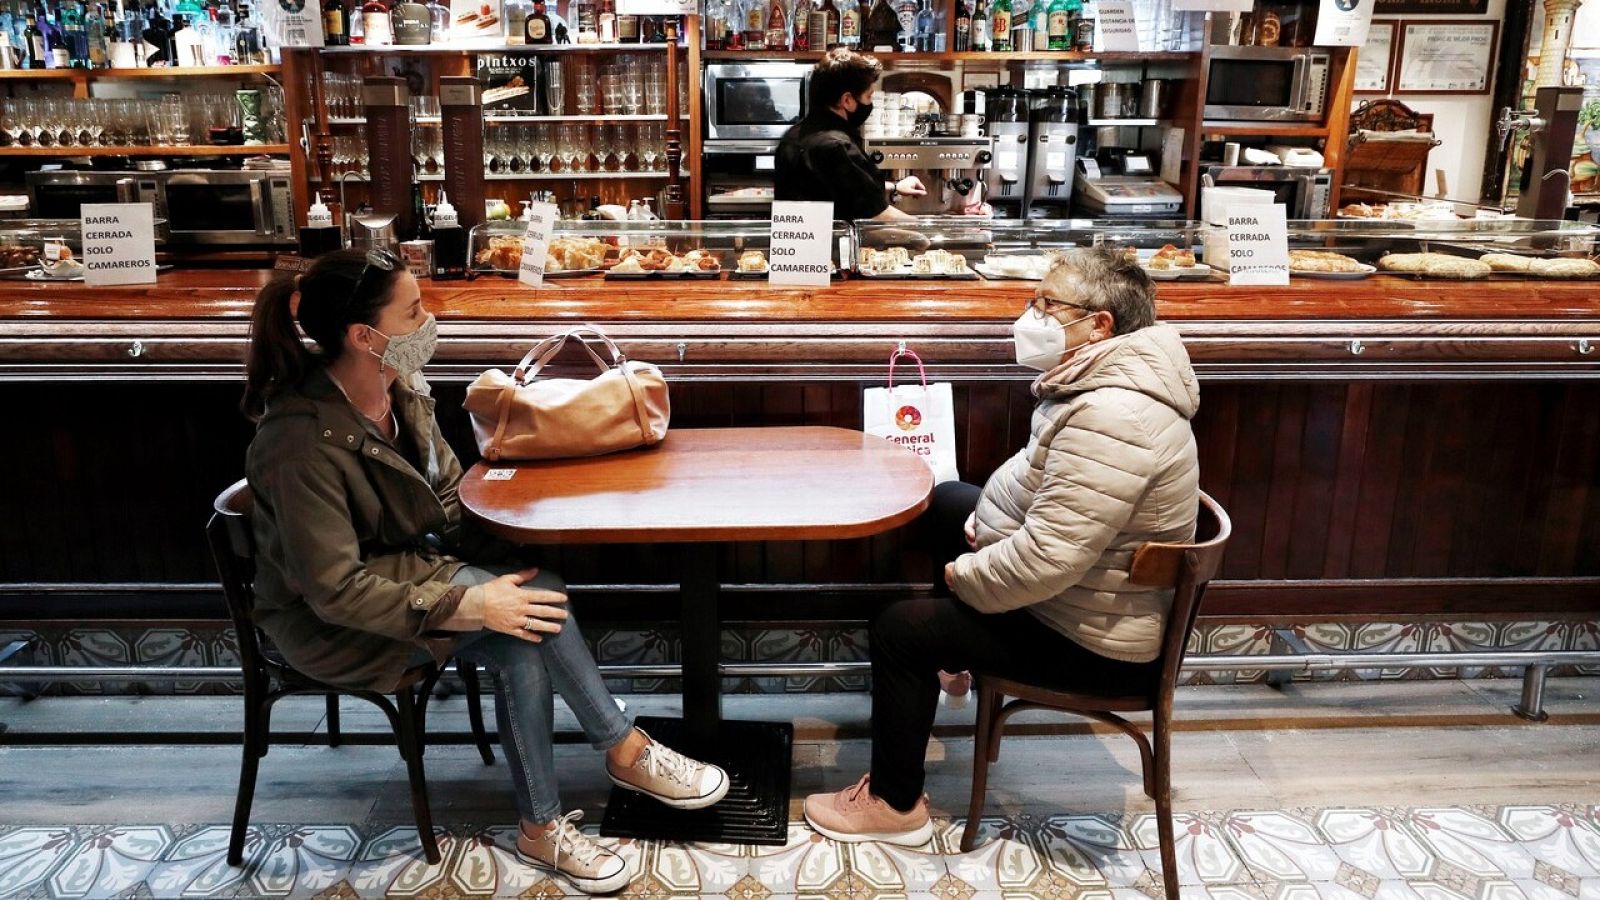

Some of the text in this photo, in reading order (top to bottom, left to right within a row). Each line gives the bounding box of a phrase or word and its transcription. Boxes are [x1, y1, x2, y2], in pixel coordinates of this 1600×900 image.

[477, 55, 537, 71] pintxos
[85, 216, 119, 225] BARRA
[773, 215, 804, 223] BARRA
[1229, 217, 1258, 226] BARRA
[85, 231, 133, 240] CERRADA
[772, 231, 815, 240] CERRADA
[1230, 233, 1271, 241] CERRADA
[86, 246, 113, 255] SOLO
[771, 247, 796, 256] SOLO
[1230, 249, 1254, 258] SOLO
[87, 260, 151, 270] CAMAREROS
[770, 263, 828, 273] CAMAREROS
[885, 433, 935, 445] General
